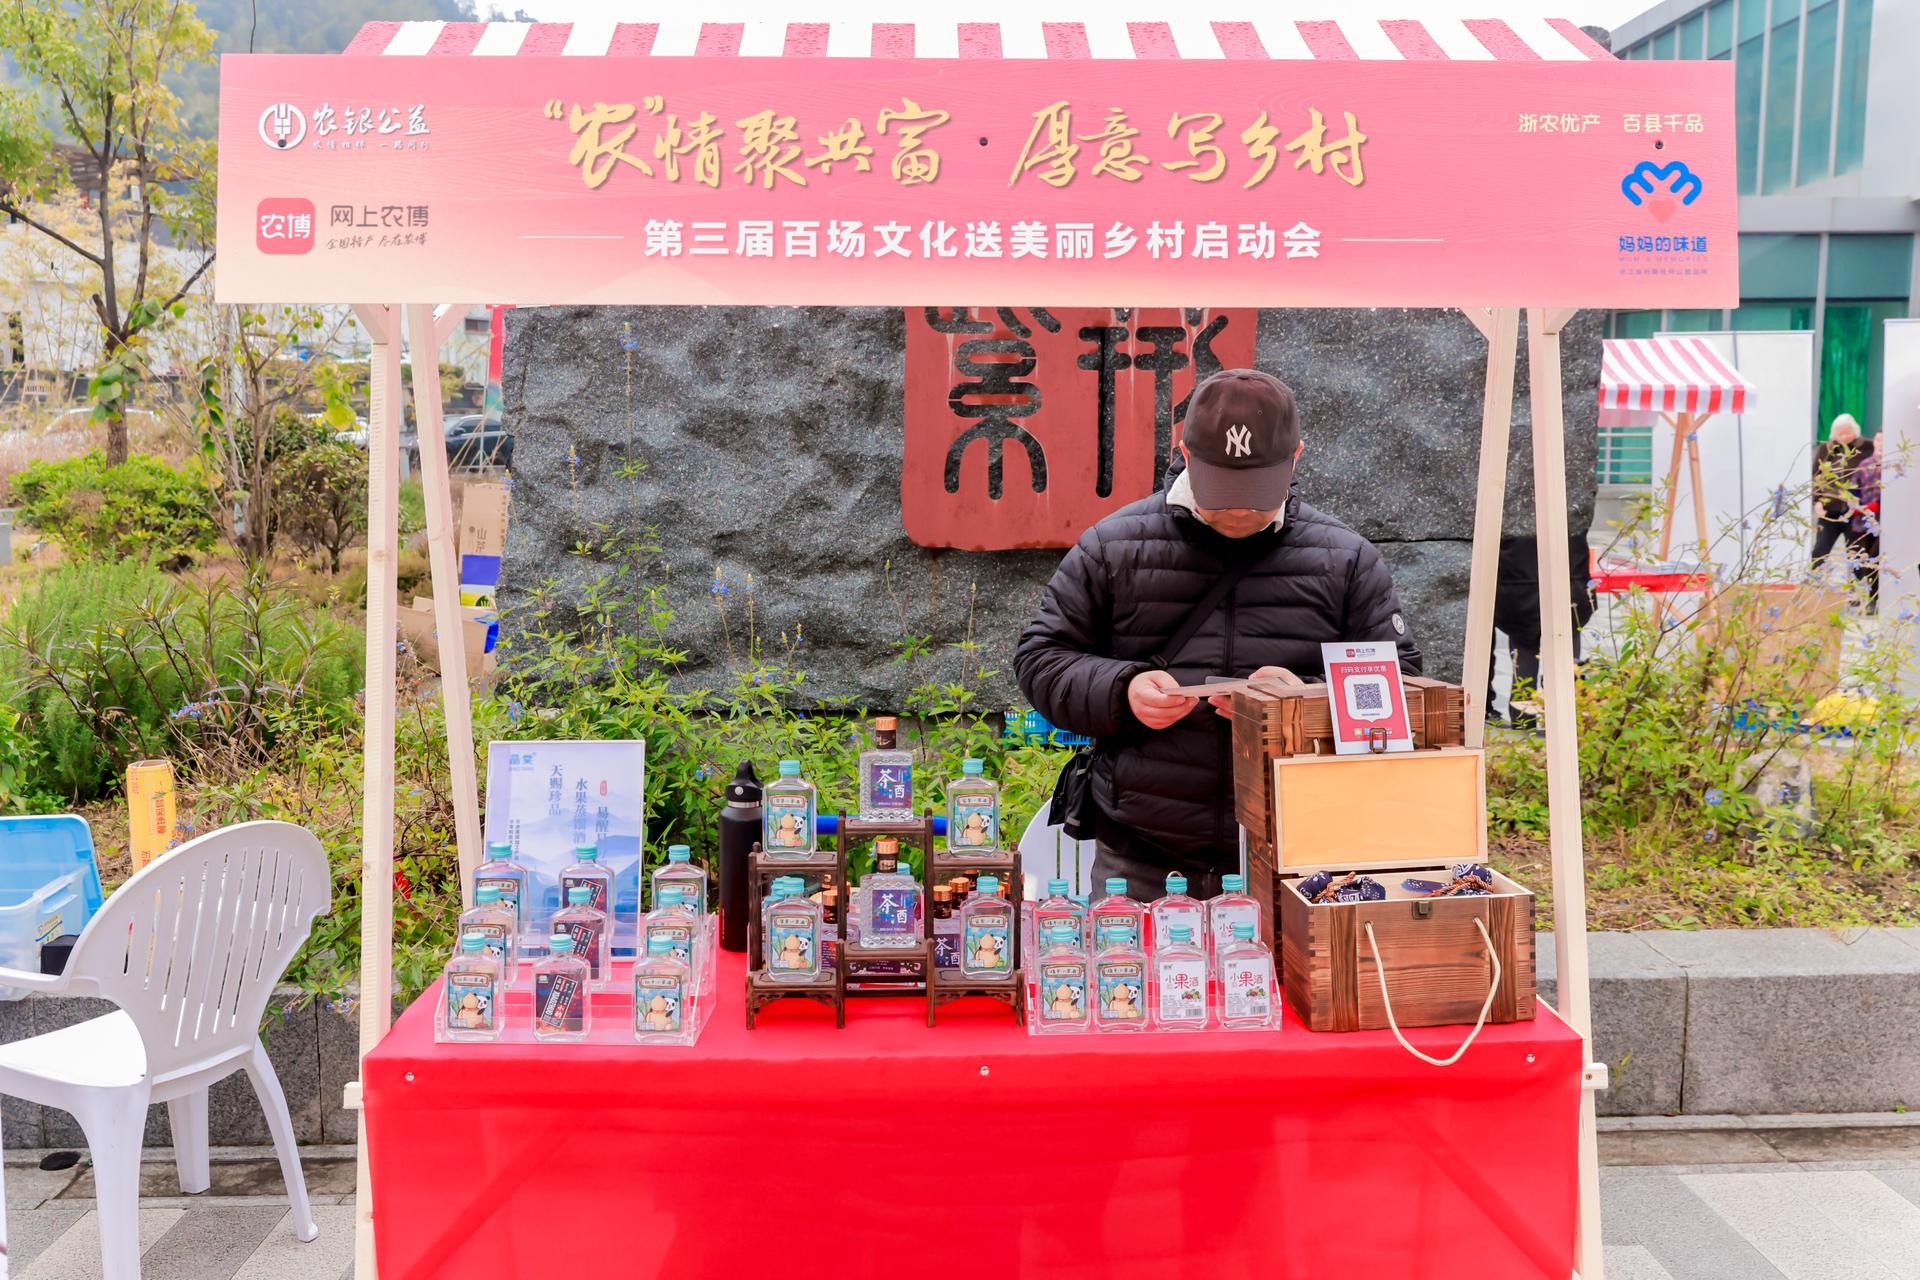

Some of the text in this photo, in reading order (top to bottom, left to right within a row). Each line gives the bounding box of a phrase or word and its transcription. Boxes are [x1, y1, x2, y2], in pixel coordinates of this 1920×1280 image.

[313, 102, 431, 136] 农银公益
[1518, 113, 1704, 133] 浙农优产 百县千品
[260, 213, 312, 240] 农博
[330, 205, 429, 228] 网上农博
[643, 218, 1322, 260] 第三届百场文化送美丽乡村启动会
[1618, 235, 1708, 253] 妈妈的味道
[876, 768, 905, 799] 茶酒
[878, 893, 907, 924] 茶酒
[1165, 973, 1199, 990] 小果酒
[1230, 971, 1263, 988] 小果酒
